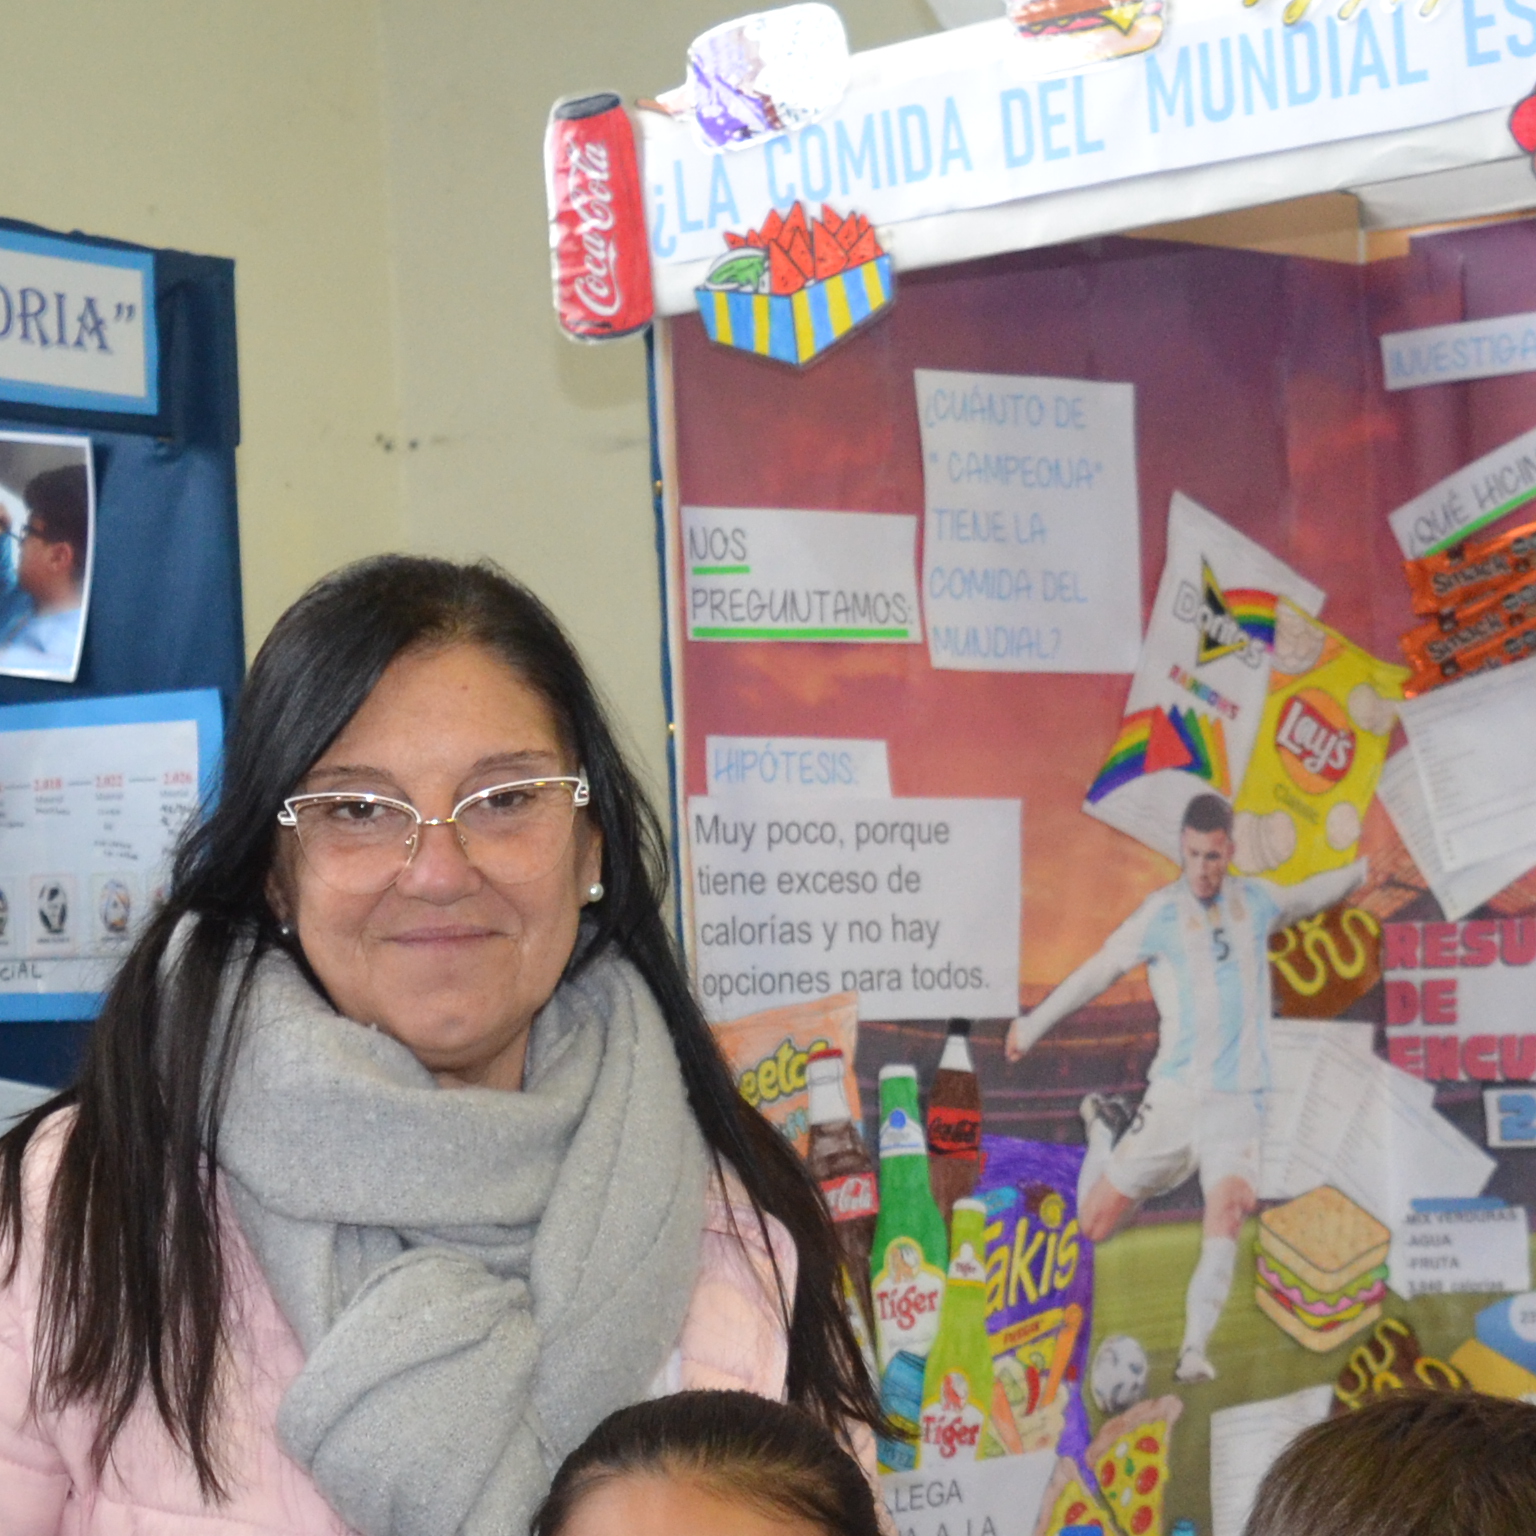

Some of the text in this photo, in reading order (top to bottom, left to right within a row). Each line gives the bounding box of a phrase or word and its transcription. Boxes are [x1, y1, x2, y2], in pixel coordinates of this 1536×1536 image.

[651, 155, 741, 258] ¿LA
[763, 97, 973, 216] COMIDA
[999, 75, 1105, 169] DEL
[1145, 2, 1428, 134] MUNDIAL
[925, 387, 1087, 430] ¿CUÁNTO DE
[933, 507, 1046, 543] TIENE LA
[689, 526, 748, 563] NOS
[929, 566, 1088, 604] COMIDA DEL
[691, 586, 914, 626] PREGUNTAMOS:
[932, 625, 1062, 660] MUNDIAL?
[695, 815, 950, 849] Muy poco, porque
[698, 865, 921, 896] tiene exceso de
[701, 911, 939, 951] calorías y no hay
[1213, 927, 1229, 963] 5
[702, 960, 990, 1003] opciones para todos.
[1384, 978, 1459, 1025] DE
